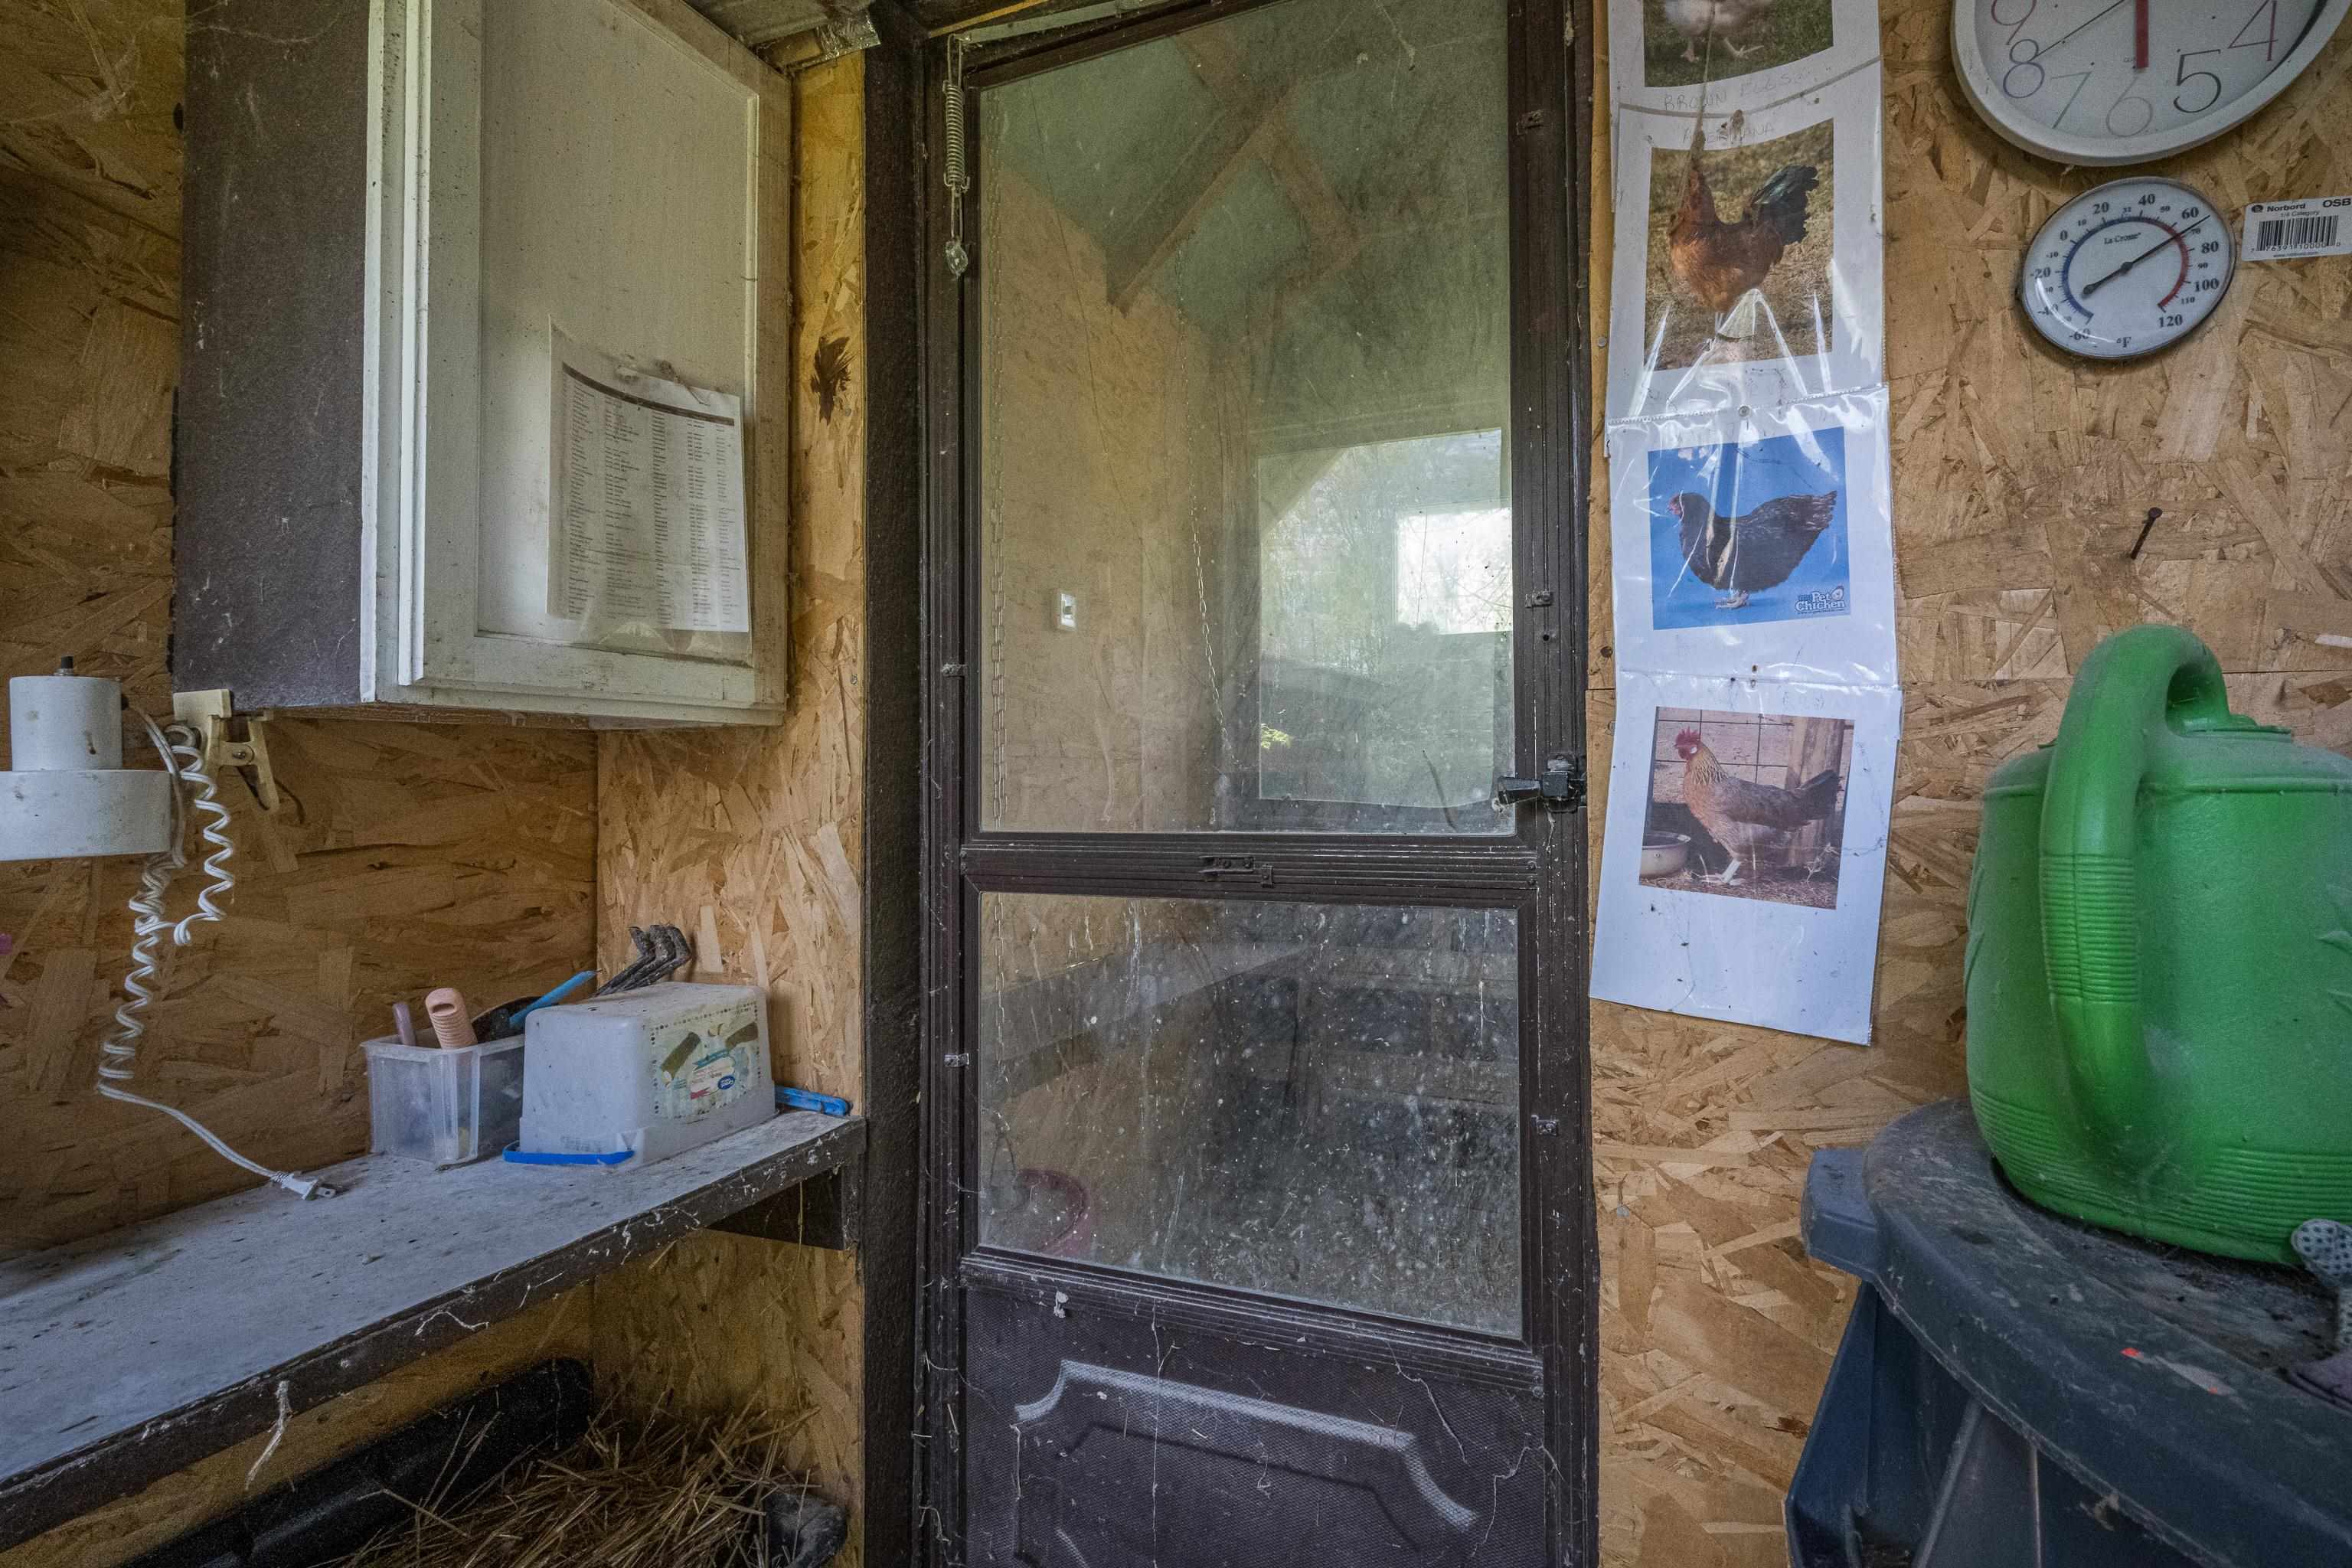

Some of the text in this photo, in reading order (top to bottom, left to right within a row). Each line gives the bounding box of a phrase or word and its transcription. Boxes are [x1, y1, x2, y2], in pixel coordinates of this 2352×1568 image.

[1991, 0, 2037, 45] 9
[2227, 0, 2278, 62] 4
[2002, 38, 2045, 99] 8
[2173, 48, 2221, 113] 5
[2050, 70, 2094, 129] 7
[2106, 69, 2153, 137] 6
[2138, 194, 2155, 206] 40
[2267, 198, 2351, 212] Norbord OSB
[2092, 201, 2109, 214] 20
[2182, 207, 2199, 220] 60
[2060, 230, 2068, 241] 0
[2201, 241, 2219, 254] 80
[2030, 267, 2051, 279] -20
[2195, 278, 2220, 292] 100
[2181, 296, 2196, 305] 110
[2159, 314, 2183, 328] 120
[2069, 328, 2091, 341] -60
[1811, 591, 1831, 603] Pet
[1795, 599, 1845, 611] Chicken
